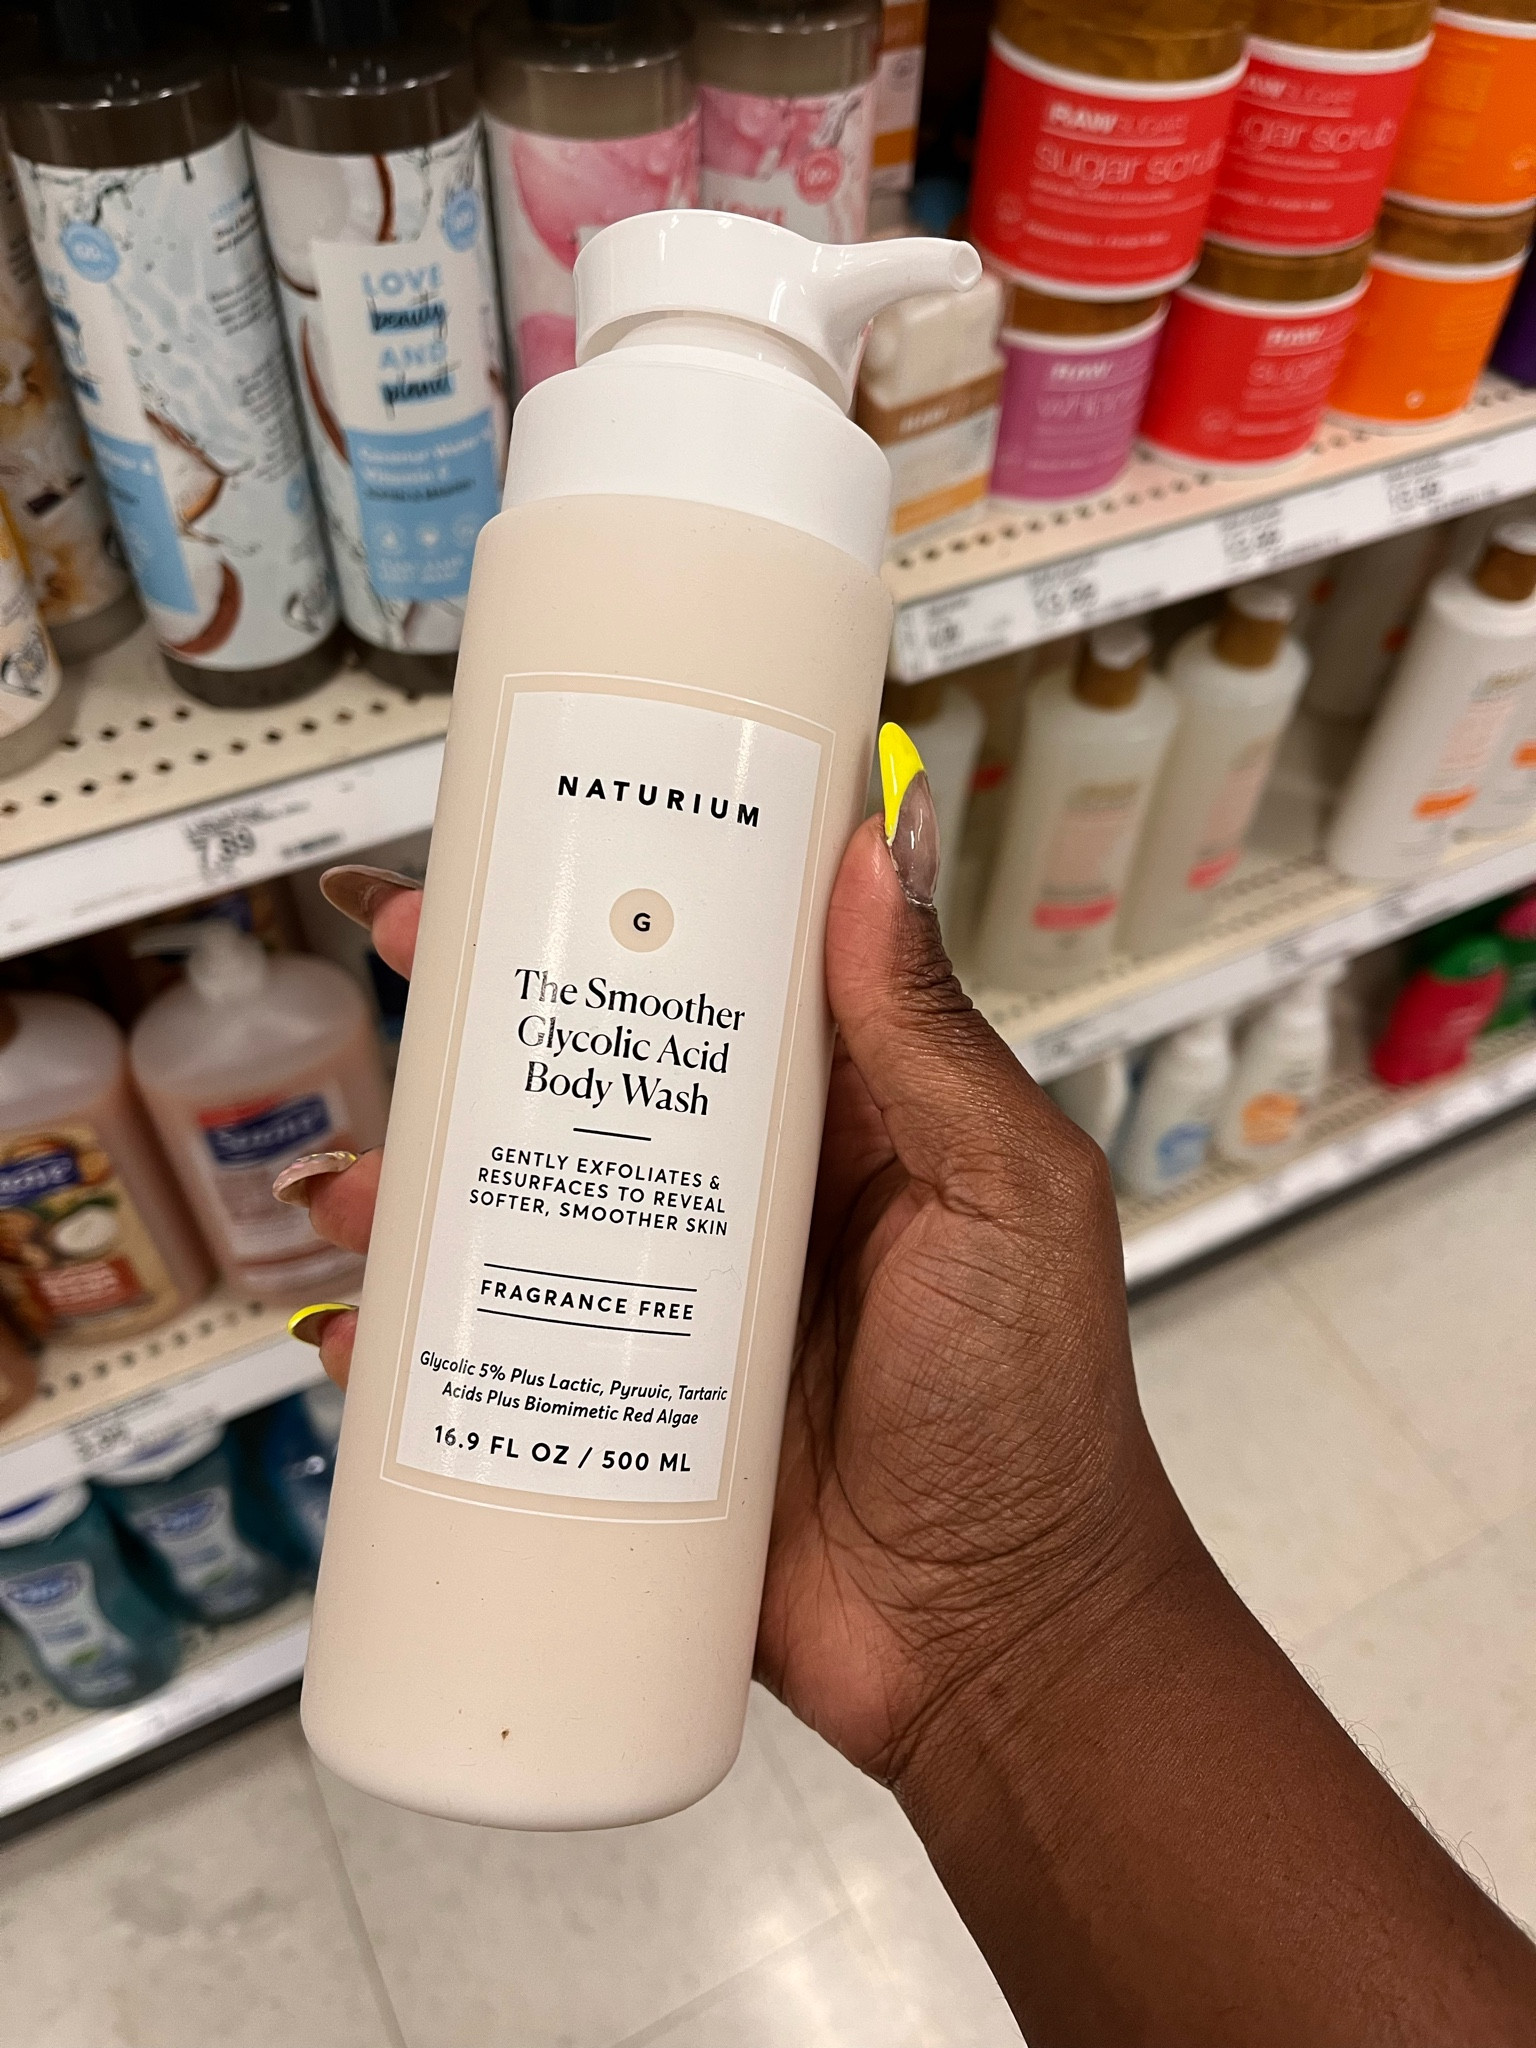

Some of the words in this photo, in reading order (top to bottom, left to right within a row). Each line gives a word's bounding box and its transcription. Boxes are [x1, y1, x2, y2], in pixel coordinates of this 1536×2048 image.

[361, 264, 443, 297] LOVE
[558, 775, 760, 828] NATURIUM
[633, 912, 651, 932] G
[514, 968, 578, 1006] The
[585, 977, 746, 1031] Smoother
[517, 1015, 651, 1061] Glycolic
[656, 1034, 730, 1074] Acid
[524, 1061, 613, 1109] Body
[622, 1073, 709, 1116] Wash
[478, 1167, 608, 1199] RESURFACES
[618, 1186, 645, 1203] TO
[653, 1191, 726, 1213] REVEAL
[491, 1146, 569, 1170] GENTLY
[576, 1158, 703, 1188] EXFOLIATES
[709, 1175, 720, 1190] &
[469, 1189, 550, 1217] SOFTER,
[559, 1202, 677, 1231] SMOOTHER
[686, 1218, 728, 1236] SKIN
[480, 1280, 628, 1314] FRAGRANCE
[639, 1301, 694, 1320] FREE
[420, 1350, 476, 1376] Glycolic
[479, 1363, 506, 1382] 5%
[510, 1367, 545, 1388] Plus
[549, 1373, 605, 1397] Lactic,
[609, 1379, 673, 1402] Pyruvic,
[678, 1385, 728, 1401] Tartaric
[442, 1381, 483, 1403] Acids
[486, 1389, 520, 1409] Plus
[524, 1395, 618, 1421] Biomimetic
[622, 1406, 654, 1424] Red
[656, 1408, 699, 1429] Algae
[434, 1425, 480, 1450] 16.9
[490, 1436, 519, 1458] FL
[531, 1442, 570, 1465] OZ
[577, 1447, 593, 1468] /
[601, 1450, 649, 1471] 500
[659, 1453, 691, 1472] ML
